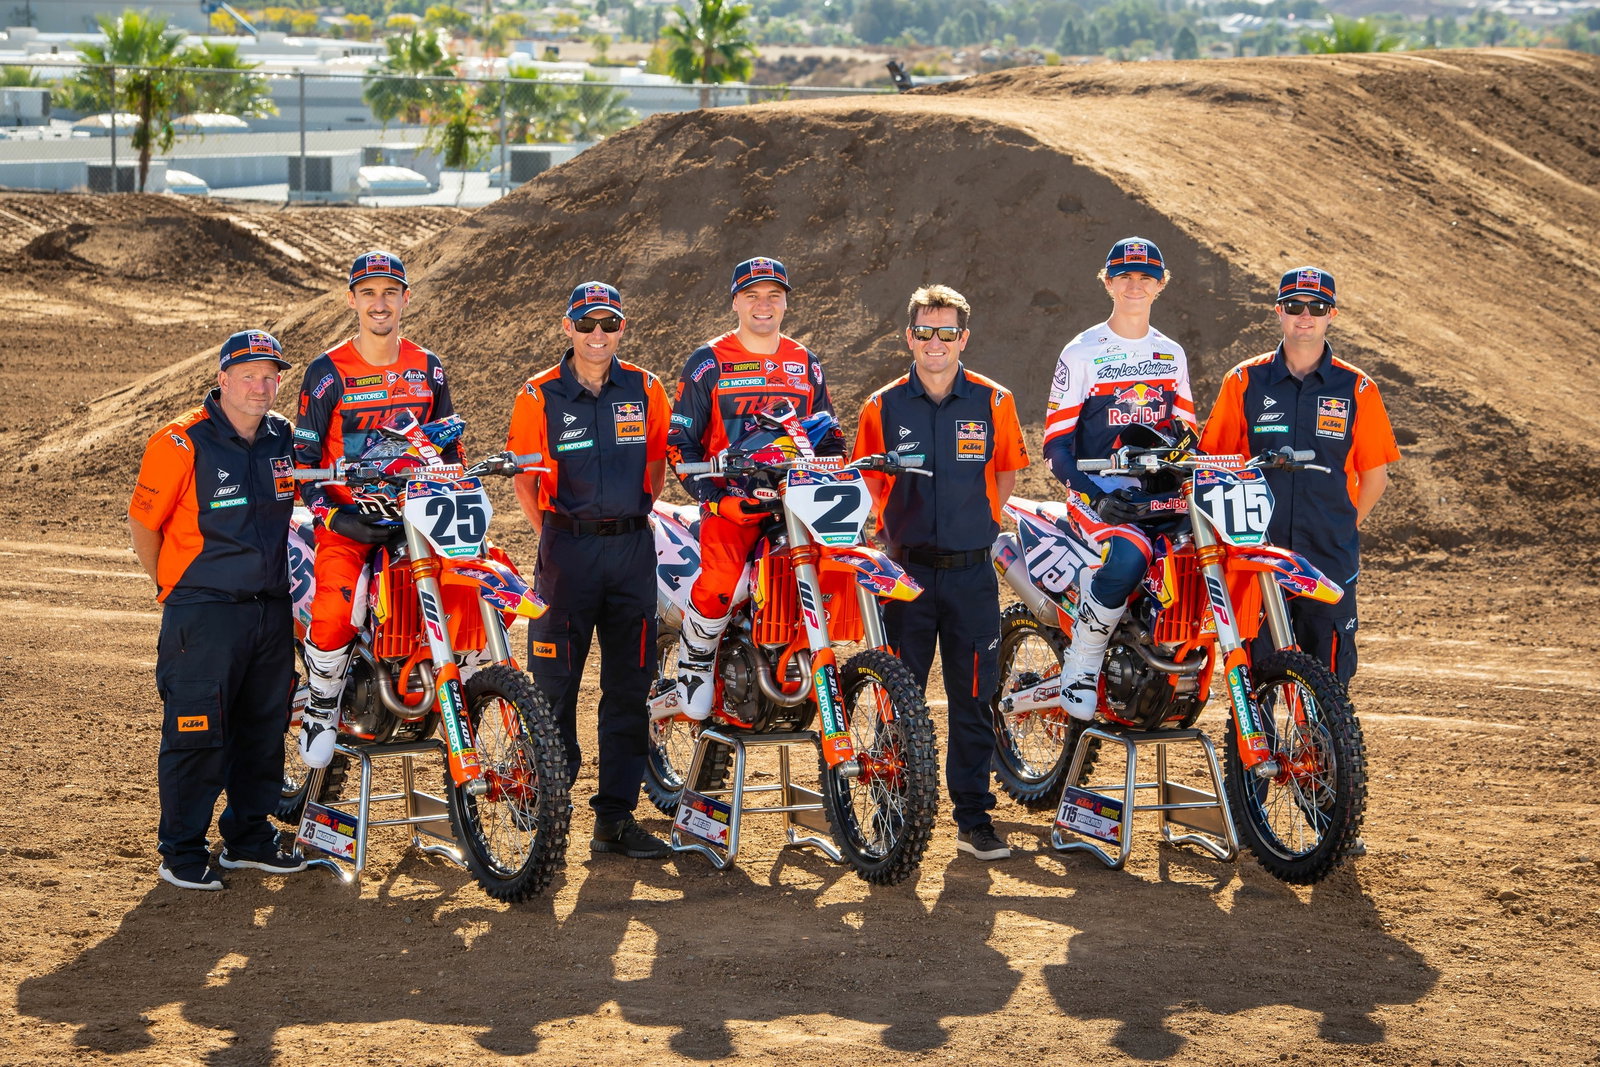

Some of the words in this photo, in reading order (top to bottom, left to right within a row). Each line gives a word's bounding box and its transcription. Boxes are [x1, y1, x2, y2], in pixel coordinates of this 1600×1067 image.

[404, 370, 426, 380] Airoh
[786, 365, 804, 373] 100%
[1120, 363, 1138, 376] Lee
[731, 379, 762, 388] MOTOREX
[354, 393, 385, 401] MOTOREX
[1109, 406, 1141, 425] Red
[1143, 404, 1166, 424] Bull
[621, 425, 639, 433] KTM
[1322, 420, 1341, 428] KTM
[295, 429, 317, 440] TOREX
[438, 424, 463, 438] AIROH
[565, 440, 592, 450] MOTOREX
[961, 443, 982, 451] KTM
[453, 482, 475, 491] KTM
[756, 490, 775, 498] BELL
[219, 498, 247, 507] MOTOREX
[811, 485, 861, 533] 2
[1150, 499, 1171, 510] Red
[1172, 498, 1188, 509] Bu
[1203, 484, 1271, 532] 115
[425, 494, 487, 546] 25
[1026, 537, 1083, 592] 115
[1010, 619, 1039, 629] DUNLOP
[535, 646, 553, 655] KTM
[857, 667, 883, 682] DUNLOP
[817, 686, 831, 735] MOTOREX
[828, 681, 846, 732] DULOP
[1231, 685, 1248, 734] MOTOREX
[1243, 677, 1264, 732] DULOP
[182, 719, 204, 729] KTM
[442, 701, 461, 752] MOTOREX
[452, 693, 472, 748] DULOP
[682, 808, 693, 825] 2
[1062, 804, 1078, 823] 115
[303, 821, 317, 840] 25
